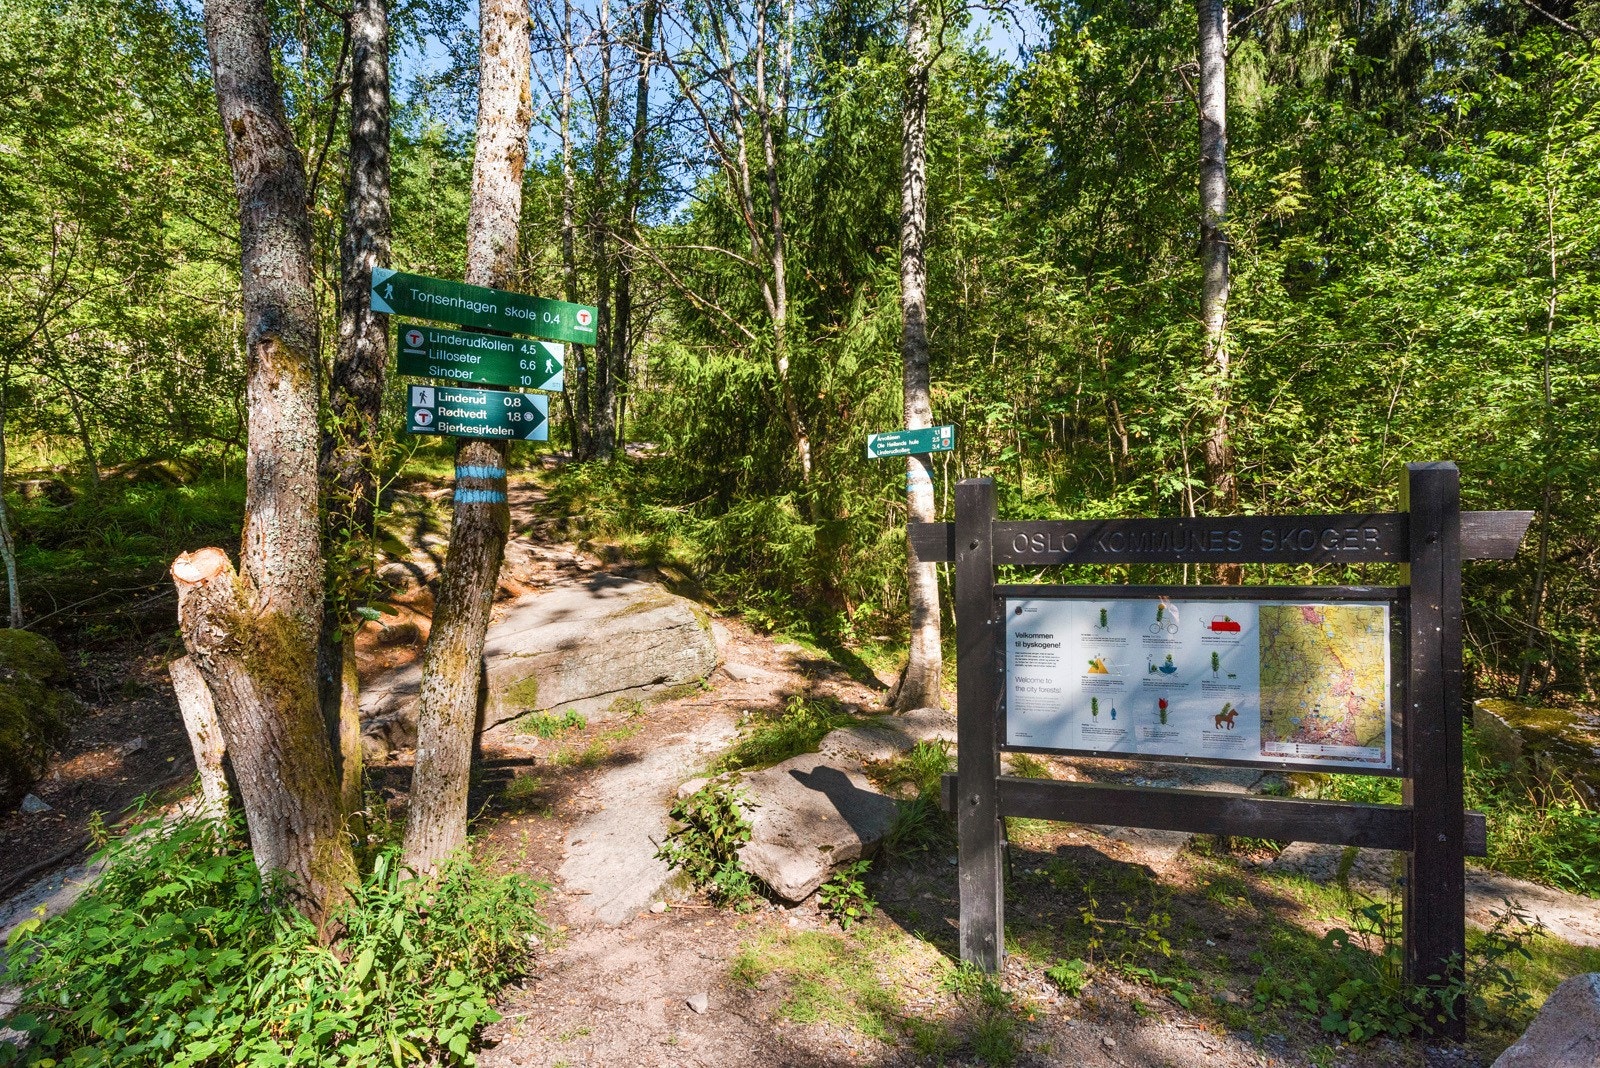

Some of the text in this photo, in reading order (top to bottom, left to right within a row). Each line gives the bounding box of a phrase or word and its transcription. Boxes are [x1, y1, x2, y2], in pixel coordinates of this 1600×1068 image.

[410, 288, 496, 313] Tonsenhagen
[505, 307, 536, 320] skole
[430, 332, 514, 352] Linderudkollen
[429, 349, 481, 364] Lilloseter
[429, 366, 531, 386] Sinober 10
[438, 392, 486, 405] Linderud
[438, 407, 487, 420] Rødtvedt
[438, 422, 514, 436] Bjerkesirkelen
[1012, 528, 1381, 554] OSLO KOMMUNES SKOGER
